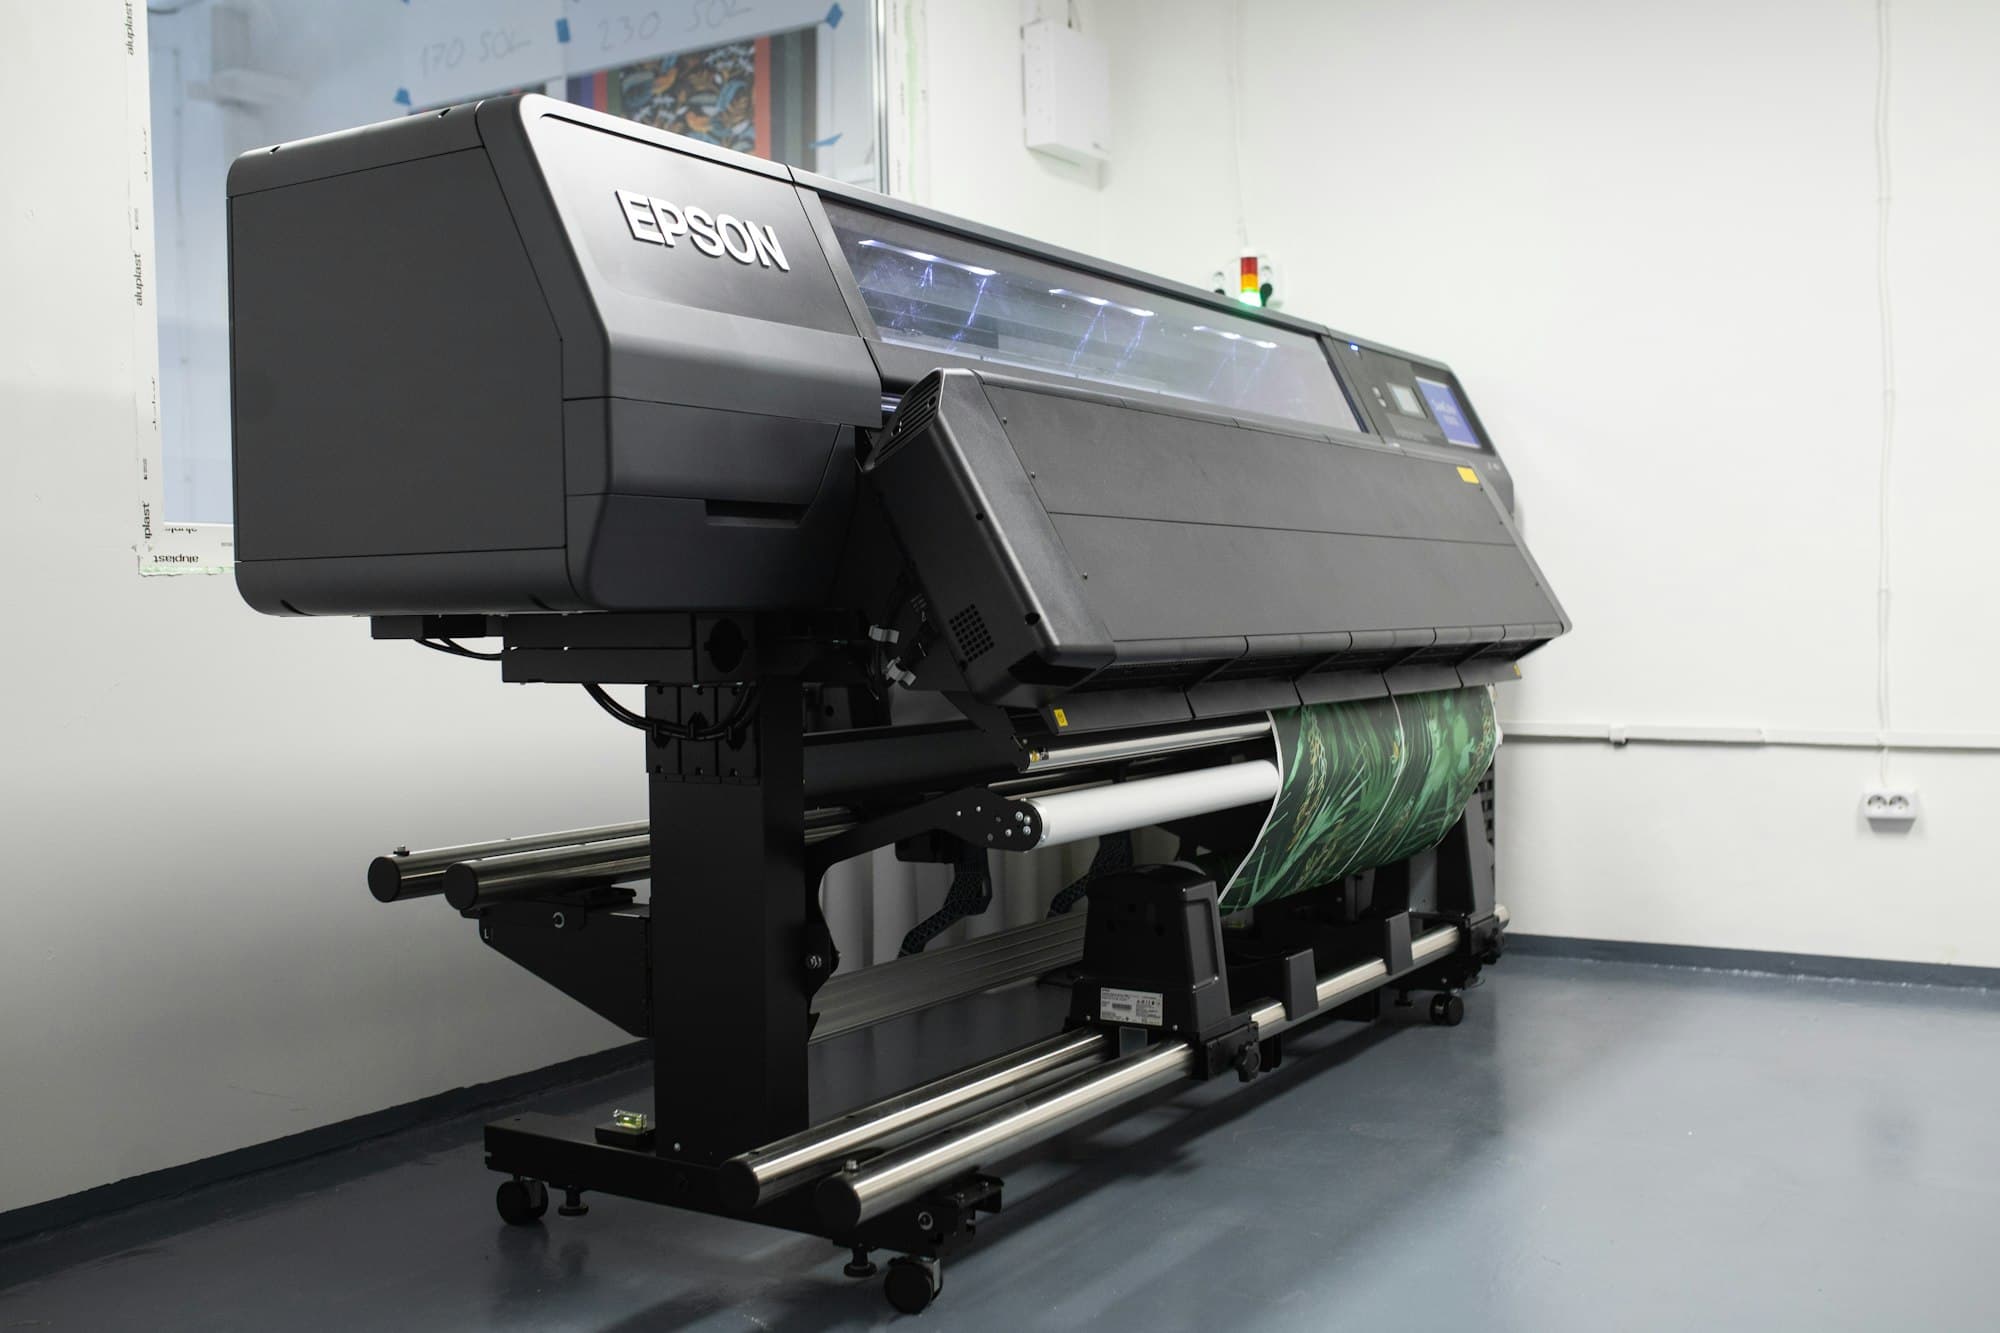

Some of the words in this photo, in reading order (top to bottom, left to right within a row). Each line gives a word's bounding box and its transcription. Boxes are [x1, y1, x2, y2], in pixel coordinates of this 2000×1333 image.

[597, 10, 661, 51] 230
[418, 36, 465, 77] 170
[614, 188, 791, 273] EPSON
[133, 253, 144, 307] aluplast
[153, 554, 199, 563] aluplast
